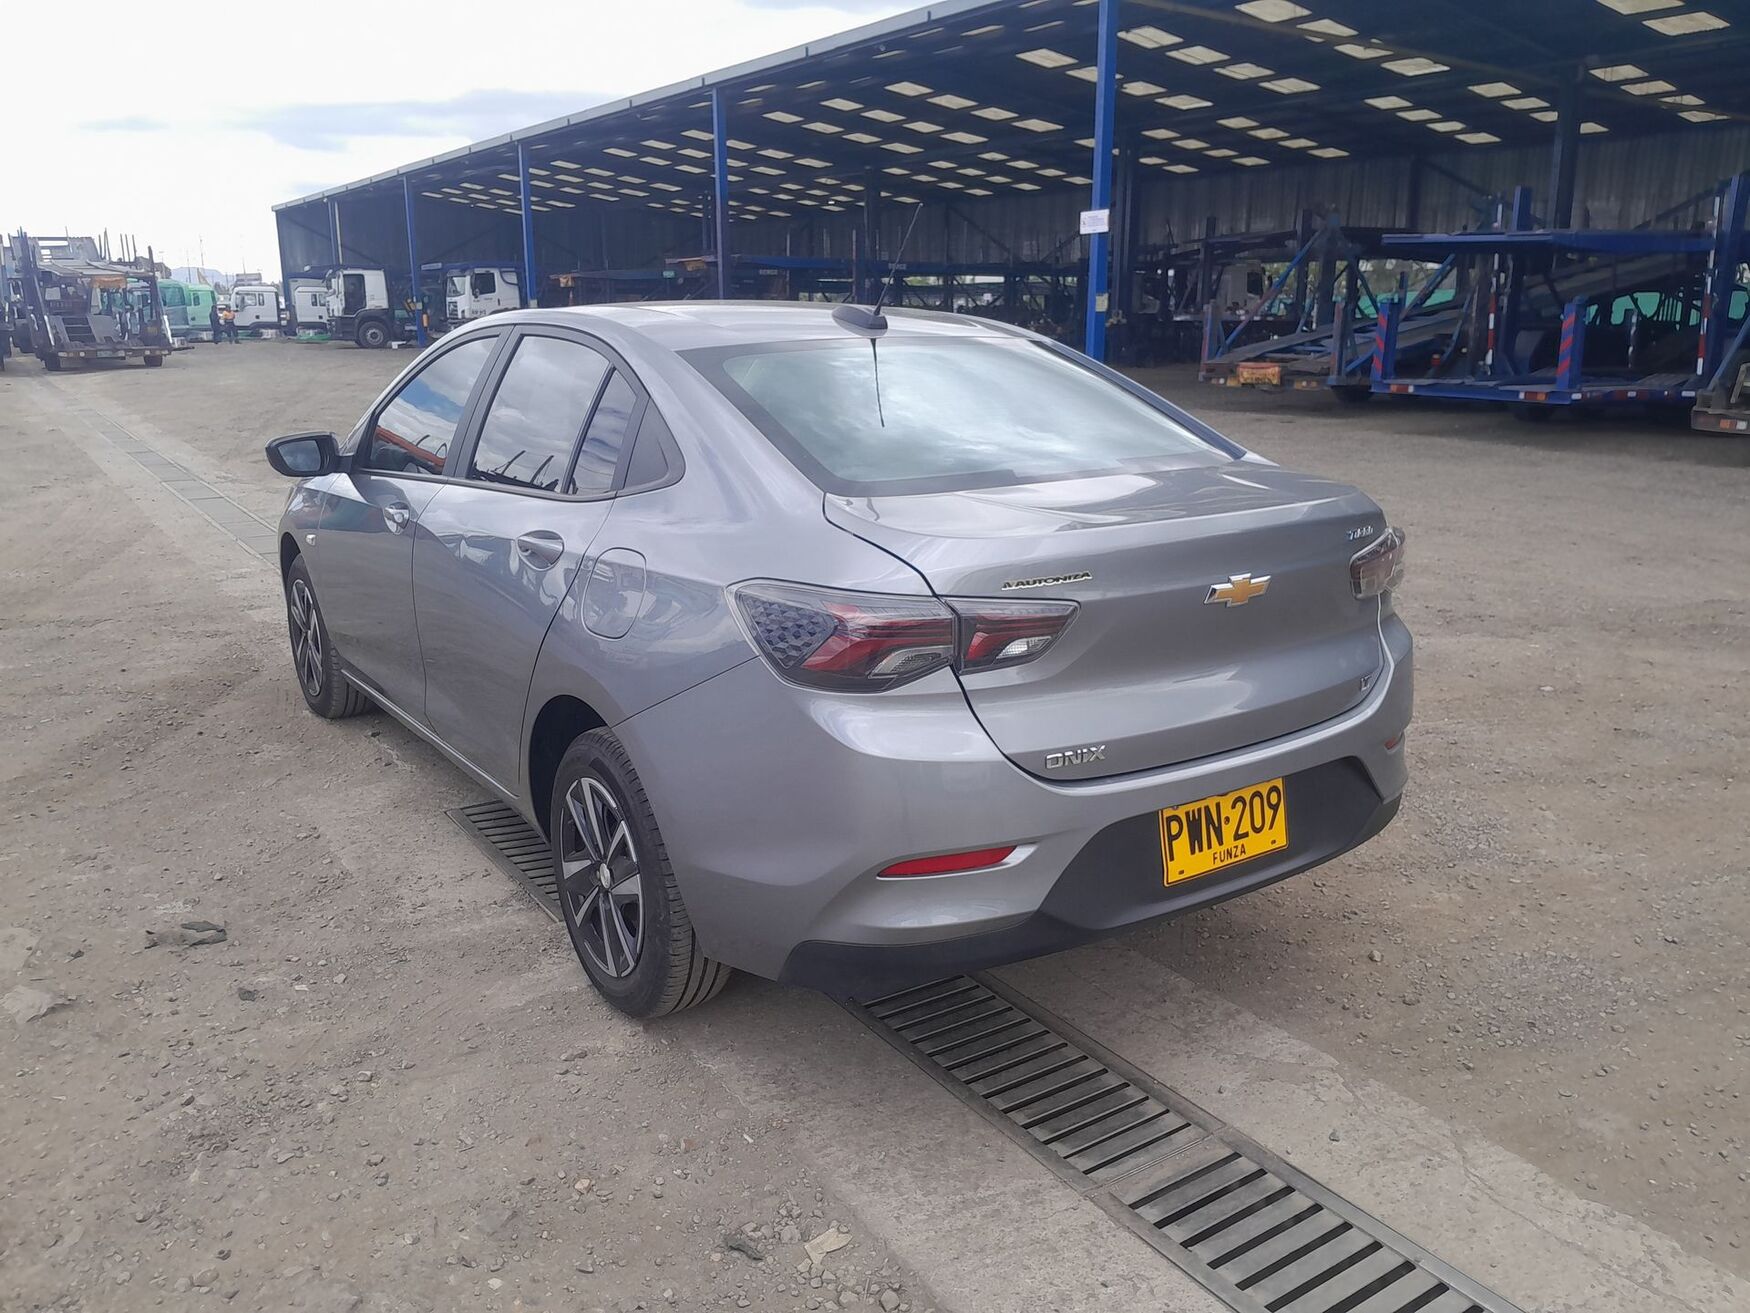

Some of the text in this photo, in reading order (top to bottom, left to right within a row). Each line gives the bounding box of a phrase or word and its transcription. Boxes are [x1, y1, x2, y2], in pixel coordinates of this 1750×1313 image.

[1014, 571, 1092, 588] AUTONIZA
[1045, 745, 1106, 769] ONIX
[1212, 843, 1247, 865] FUNZA
